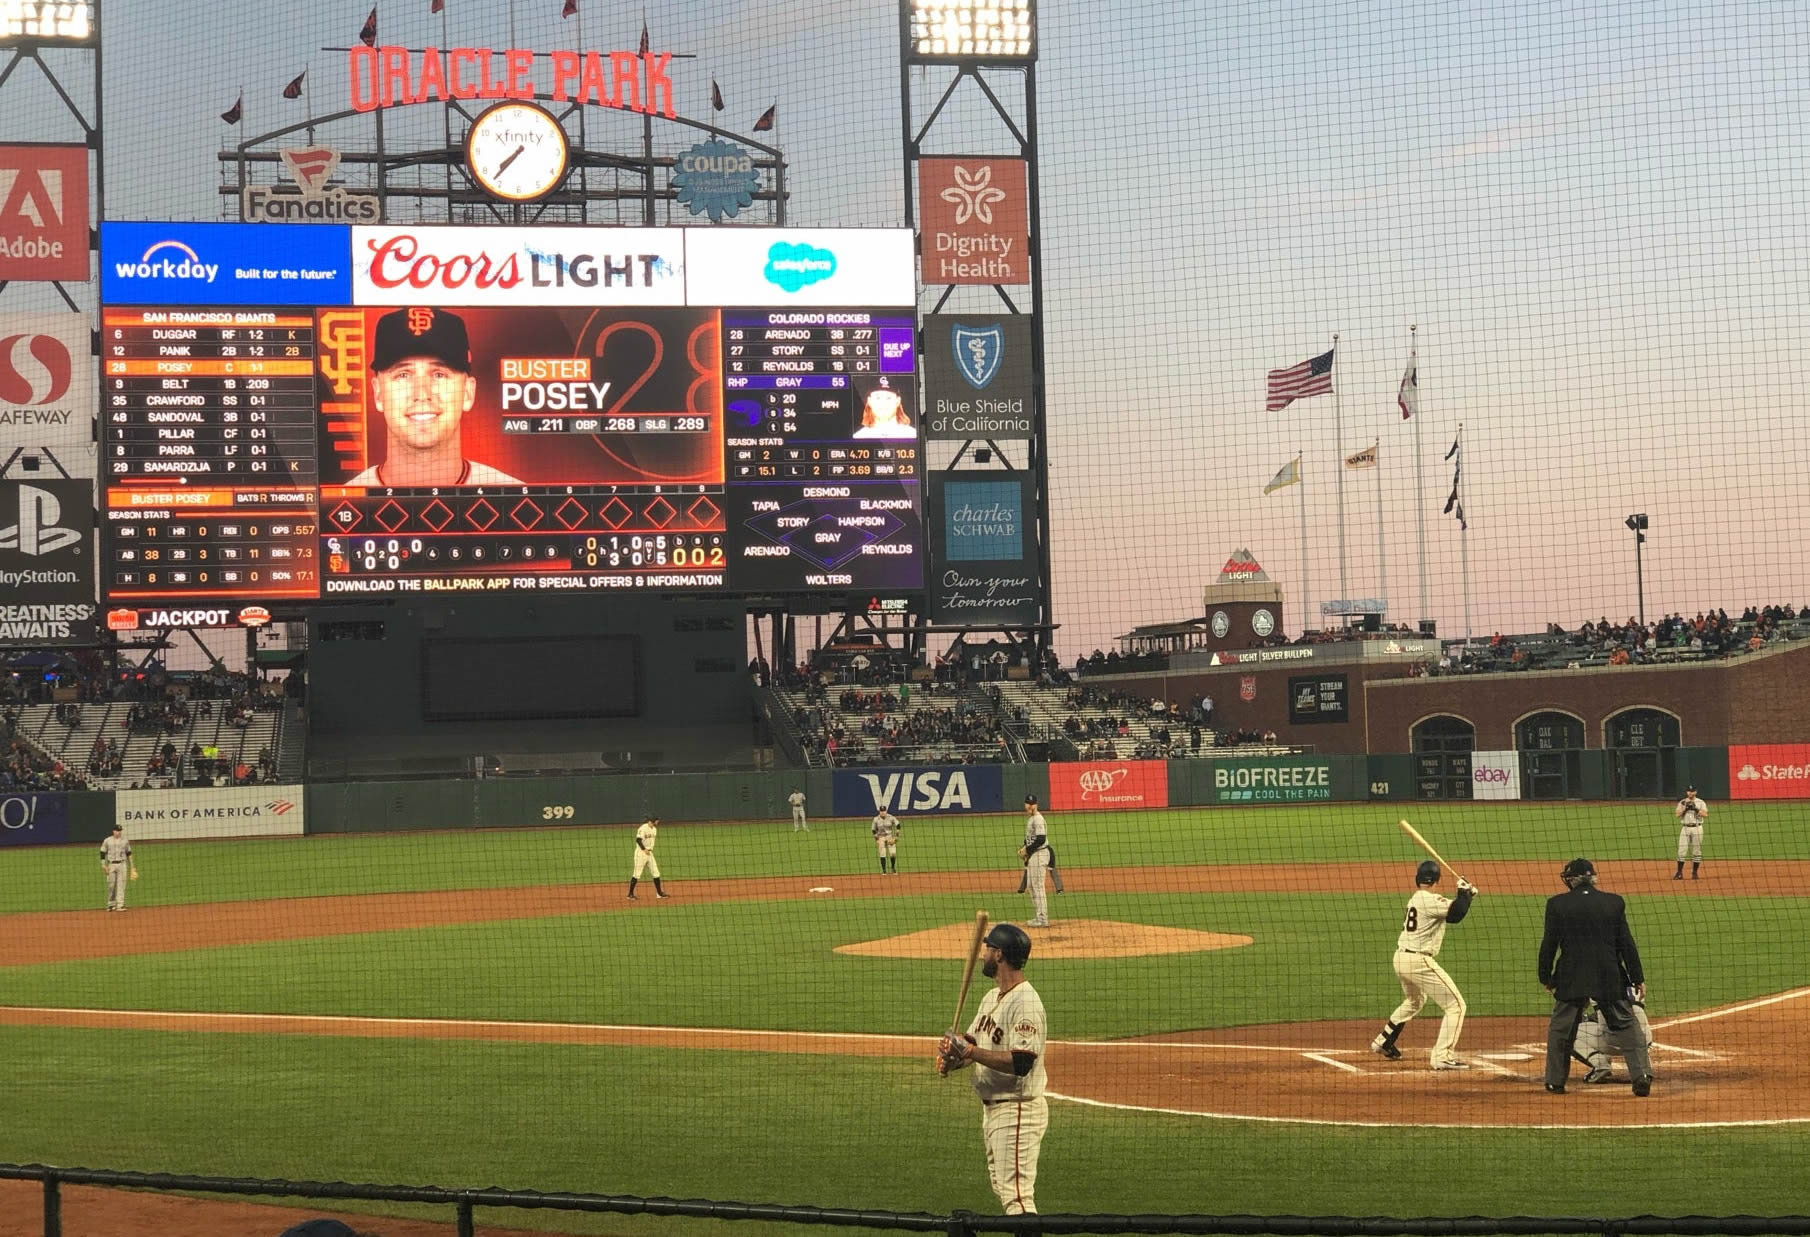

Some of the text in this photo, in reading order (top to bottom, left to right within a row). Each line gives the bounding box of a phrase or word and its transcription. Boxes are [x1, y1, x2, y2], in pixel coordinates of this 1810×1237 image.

[351, 47, 675, 119] ORACLE PARK
[496, 129, 543, 147] xfinity
[683, 156, 752, 177] coupa
[250, 192, 375, 218] Fanatics
[0, 236, 63, 258] Adobe
[936, 232, 1012, 256] Dignity
[368, 235, 659, 289] Coors LIGHT
[116, 259, 218, 282] workday
[235, 269, 260, 279] Built
[263, 269, 278, 279] for
[281, 269, 298, 279] the
[144, 313, 275, 322] SAN FRANCISCO GIANTS
[769, 314, 870, 323] COLORADO ROCKIES
[153, 330, 196, 339] DUGGAR
[730, 330, 872, 339] 28 ARENADO .277
[114, 347, 236, 355] 12 PANIK 2B
[731, 347, 743, 355] 27
[772, 346, 804, 355] STORY
[158, 363, 192, 372] POSEY
[503, 360, 587, 378] BUSTER
[732, 362, 870, 371] 12 REYNOLDS 0-1
[163, 380, 269, 389] BELT 1B .209
[728, 378, 844, 387] RHP GRAY 55
[113, 396, 265, 405] 35 CRAWFORD SS 0-1
[502, 382, 610, 409] POSEY
[783, 395, 796, 403] 20
[937, 399, 1022, 413] Blue Shield
[0, 411, 71, 424] AFEWAY
[113, 412, 204, 422] 48 SANDOVAL
[784, 409, 796, 417] 34
[505, 418, 704, 430] AVG .211 OBP .268 SLG .289
[932, 417, 1029, 431] of California
[159, 429, 238, 438] PILLAR CF
[159, 446, 237, 455] PARRA LF
[850, 450, 869, 458] 4.70
[114, 462, 210, 472] 29 SAMARDZIJA
[759, 467, 775, 475] 15.1
[804, 488, 849, 497] DESMOND
[132, 494, 210, 504] BUSTER POSEY
[238, 494, 304, 502] BATS THROWS
[752, 502, 780, 511] TAPIA
[860, 500, 912, 510] BLACKMON
[109, 511, 169, 519] SEASON STATS
[338, 511, 352, 522] 1B
[953, 503, 1013, 521] charles
[777, 518, 809, 527] STORY
[838, 517, 885, 526] HAMPSON
[293, 526, 315, 535] .557
[953, 524, 1015, 536] SCHWAB
[815, 534, 841, 543] GRAY
[297, 549, 312, 558] 7.3
[744, 547, 790, 556] ARENADO
[862, 545, 912, 554] REYNOLDS
[296, 572, 313, 580] 17.1
[806, 575, 852, 585] WOLTERS
[327, 575, 722, 591] DOWNLOAD THE BALLPARK APP FOR SPECIAL OFFERS & INFORMATION
[943, 570, 1029, 596] Own your
[942, 593, 1032, 608] tomorrow
[0, 605, 89, 621] REATNESS
[146, 611, 229, 626] JACKPOT
[0, 622, 70, 638] AWAITS
[1240, 653, 1257, 662] LIGHT
[1262, 652, 1282, 660] SILVER
[1284, 649, 1312, 659] BULLPEN
[1320, 692, 1335, 700] YOUR
[1475, 765, 1510, 786] ebay
[1762, 765, 1802, 779] State
[1082, 770, 1112, 791] AAA
[858, 772, 971, 810] VISA
[1371, 782, 1388, 794] 421
[1100, 794, 1143, 802] Insurance
[1256, 789, 1330, 799] COOL THE PAIN
[1, 797, 37, 830] O!
[124, 807, 261, 820] BANK OF AMERICA
[543, 806, 574, 819] 399
[1403, 907, 1417, 932] 8
